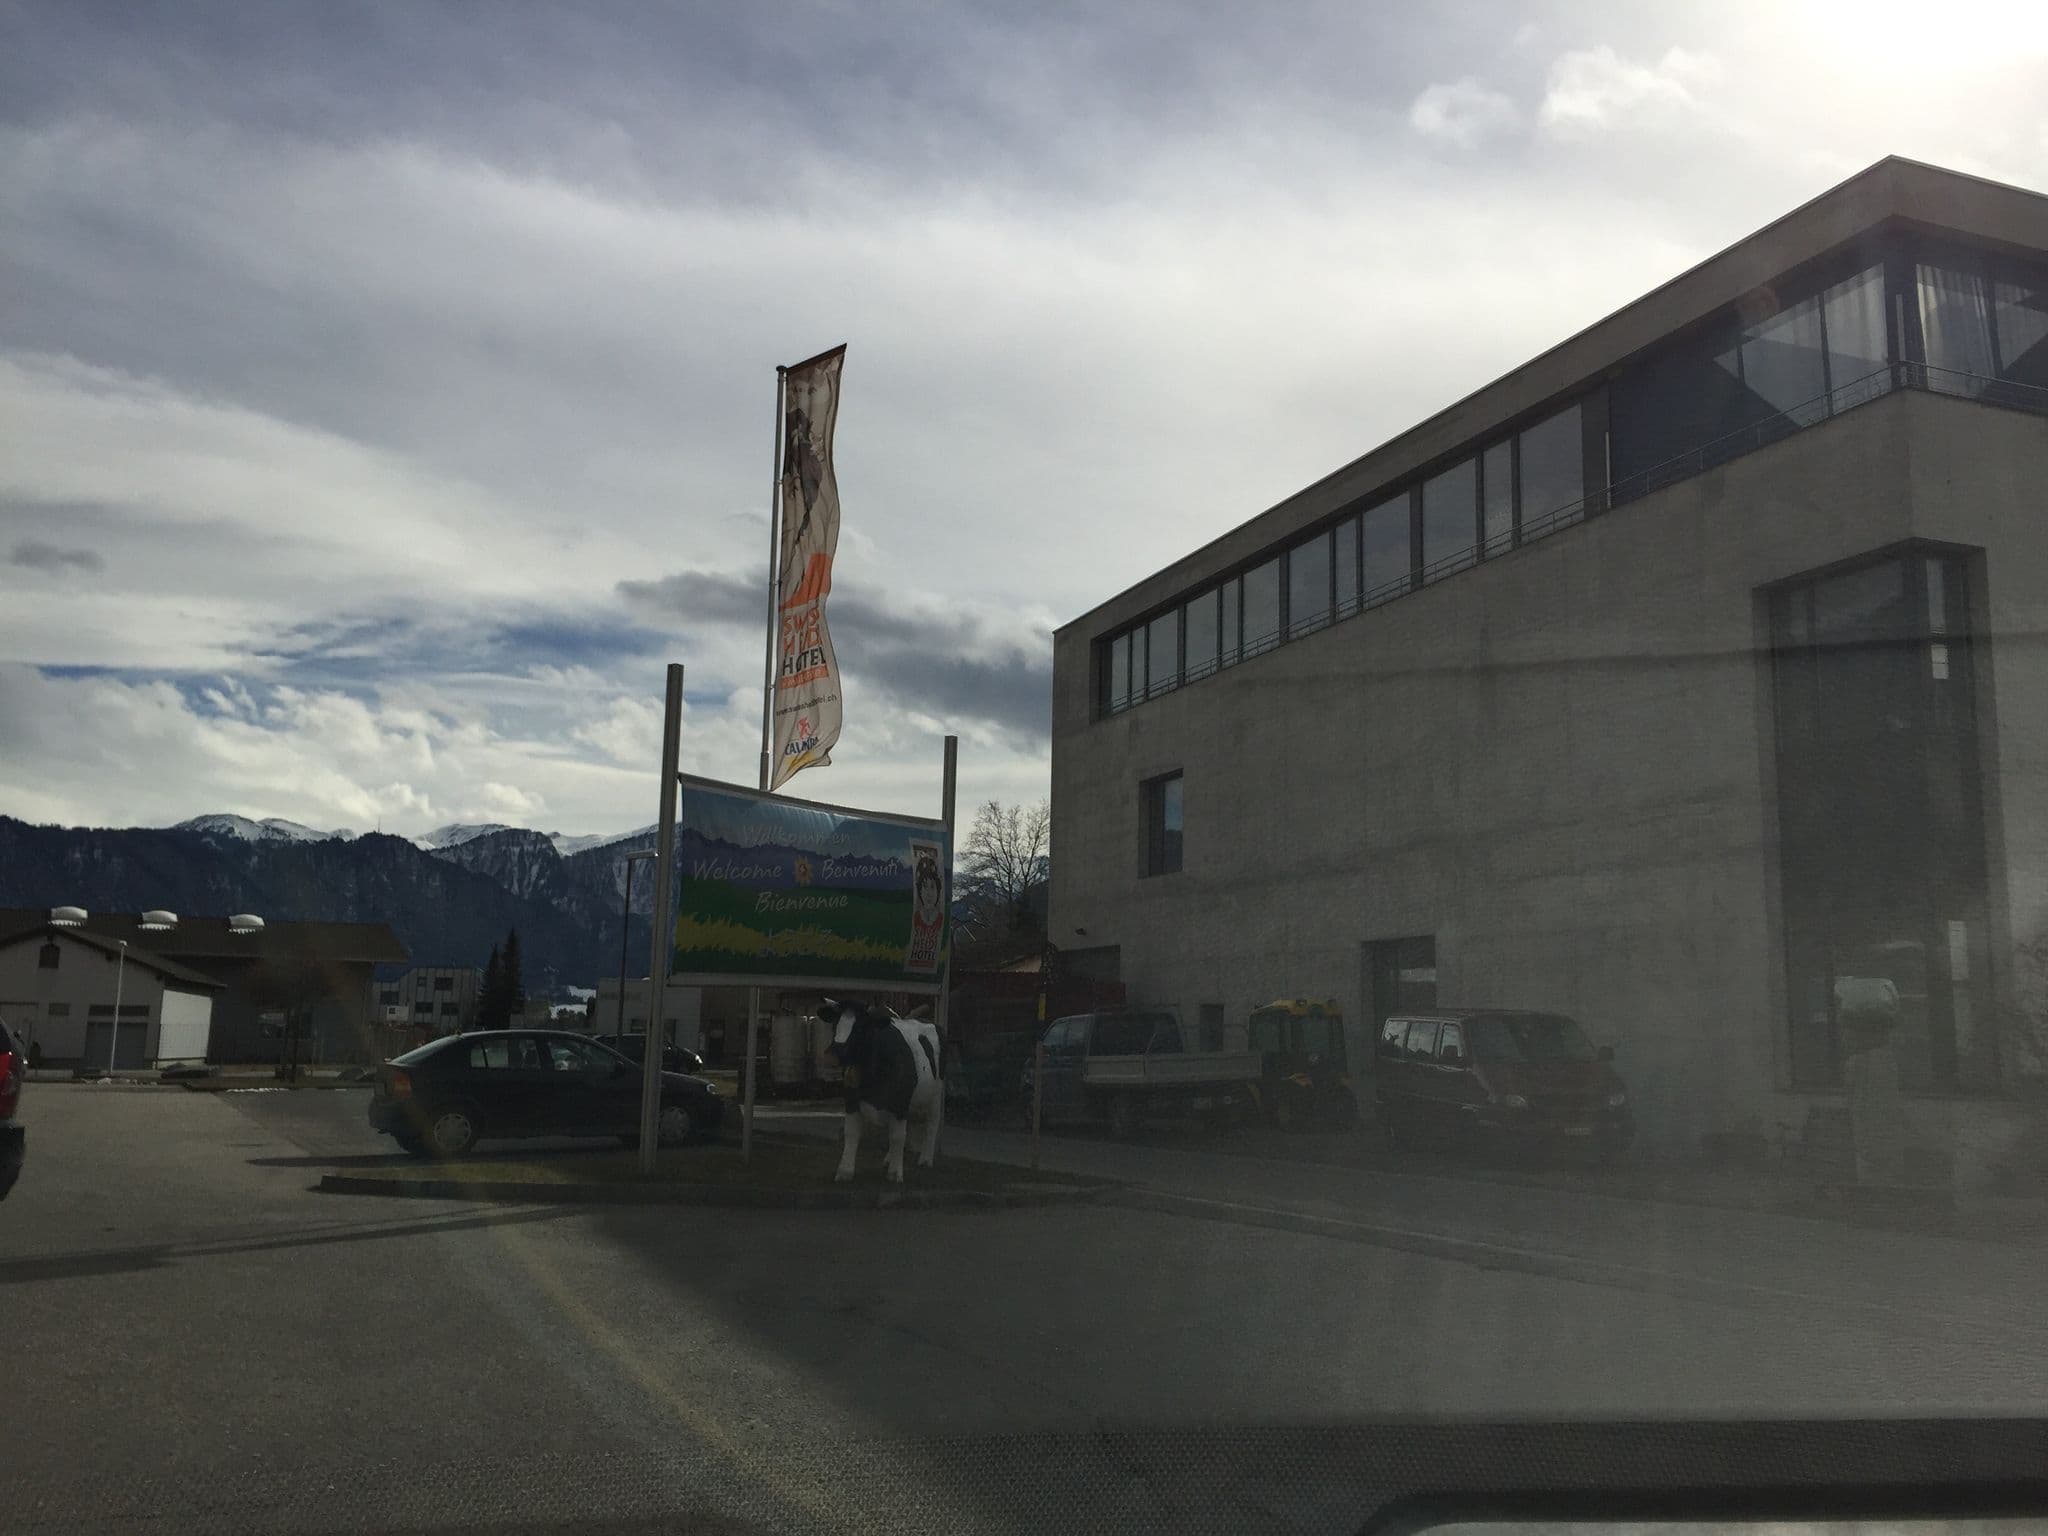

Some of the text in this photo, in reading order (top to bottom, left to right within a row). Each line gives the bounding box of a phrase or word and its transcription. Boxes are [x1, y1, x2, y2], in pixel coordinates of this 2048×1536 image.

[782, 646, 826, 676] HOTEL
[693, 857, 900, 880] Welcome Benvenuti
[754, 891, 849, 912] Bienvenue
